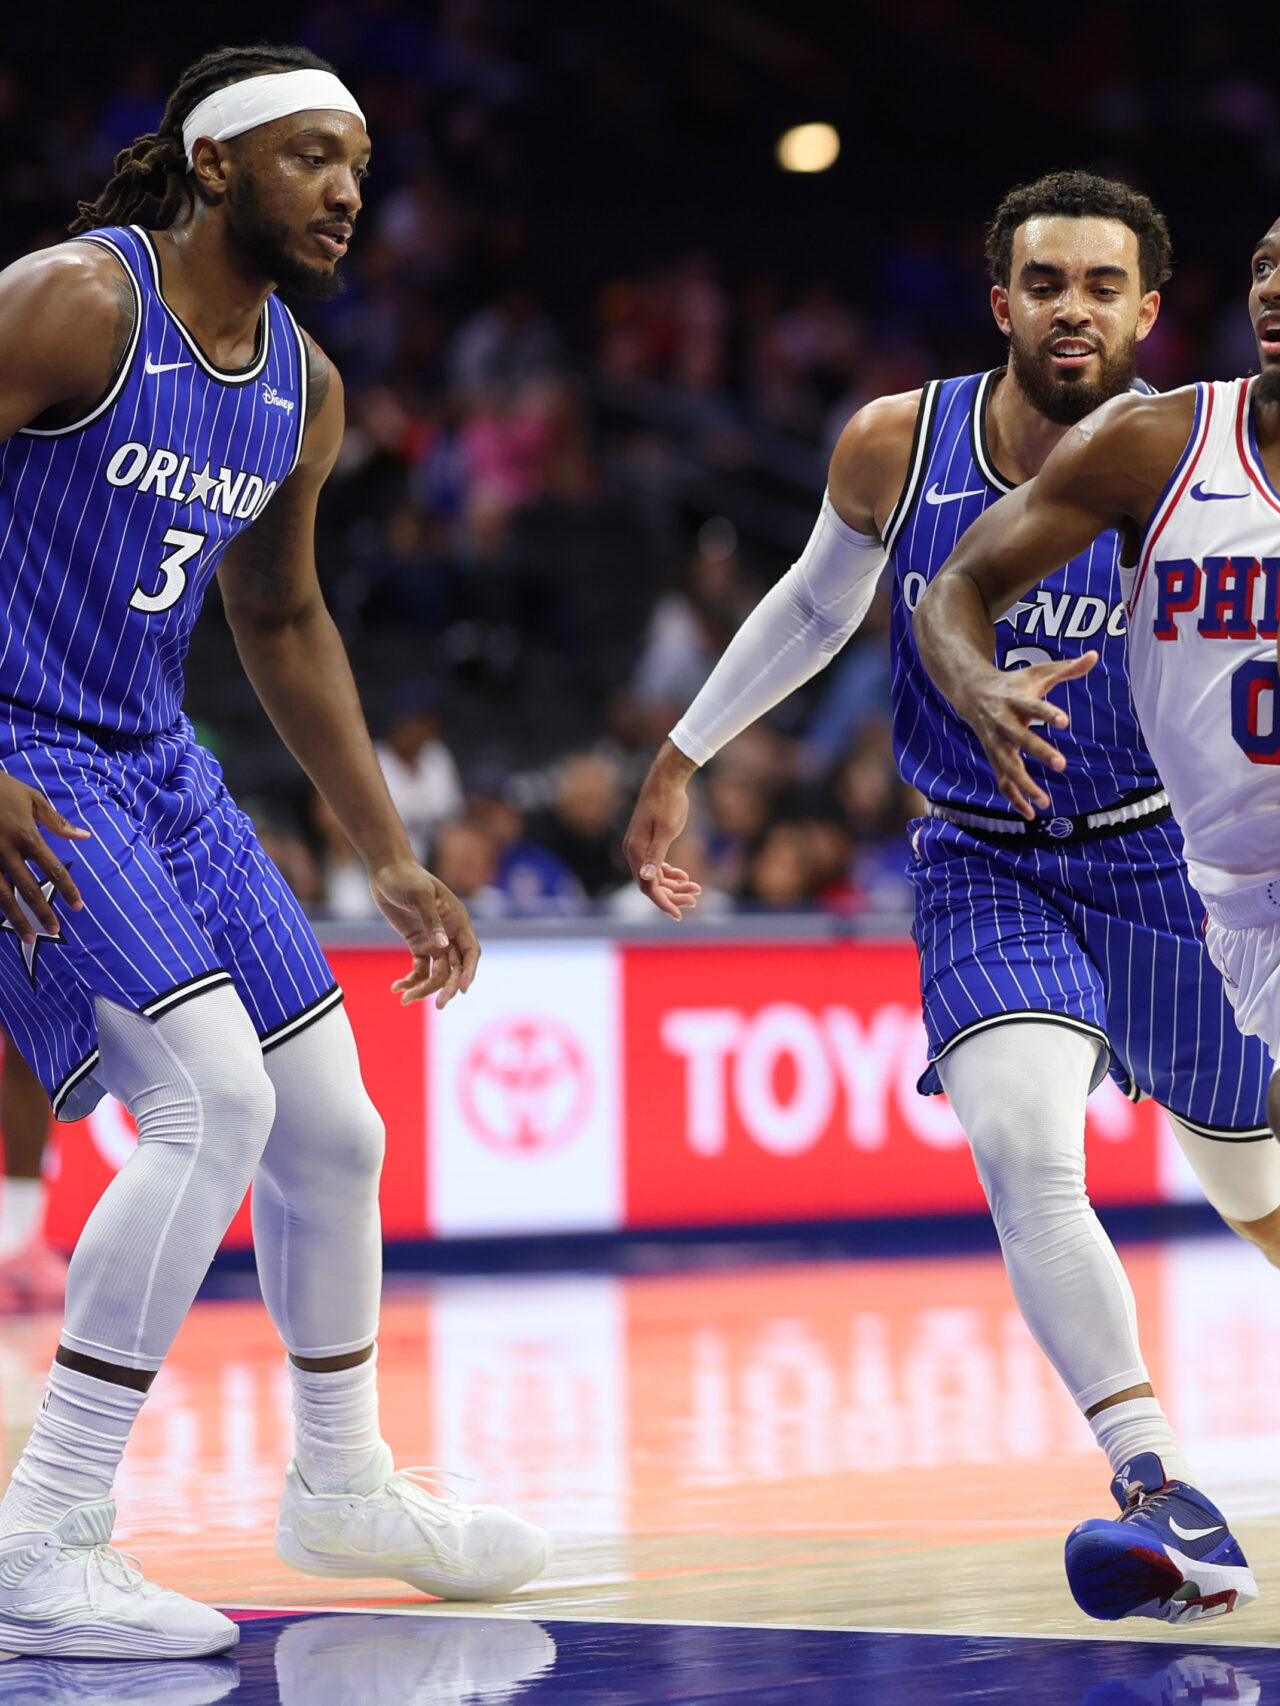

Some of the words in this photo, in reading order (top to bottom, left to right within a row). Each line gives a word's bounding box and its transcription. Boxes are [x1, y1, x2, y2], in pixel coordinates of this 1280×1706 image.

[262, 382, 295, 416] Disney
[105, 441, 278, 523] ORLANDO
[129, 527, 207, 612] 3
